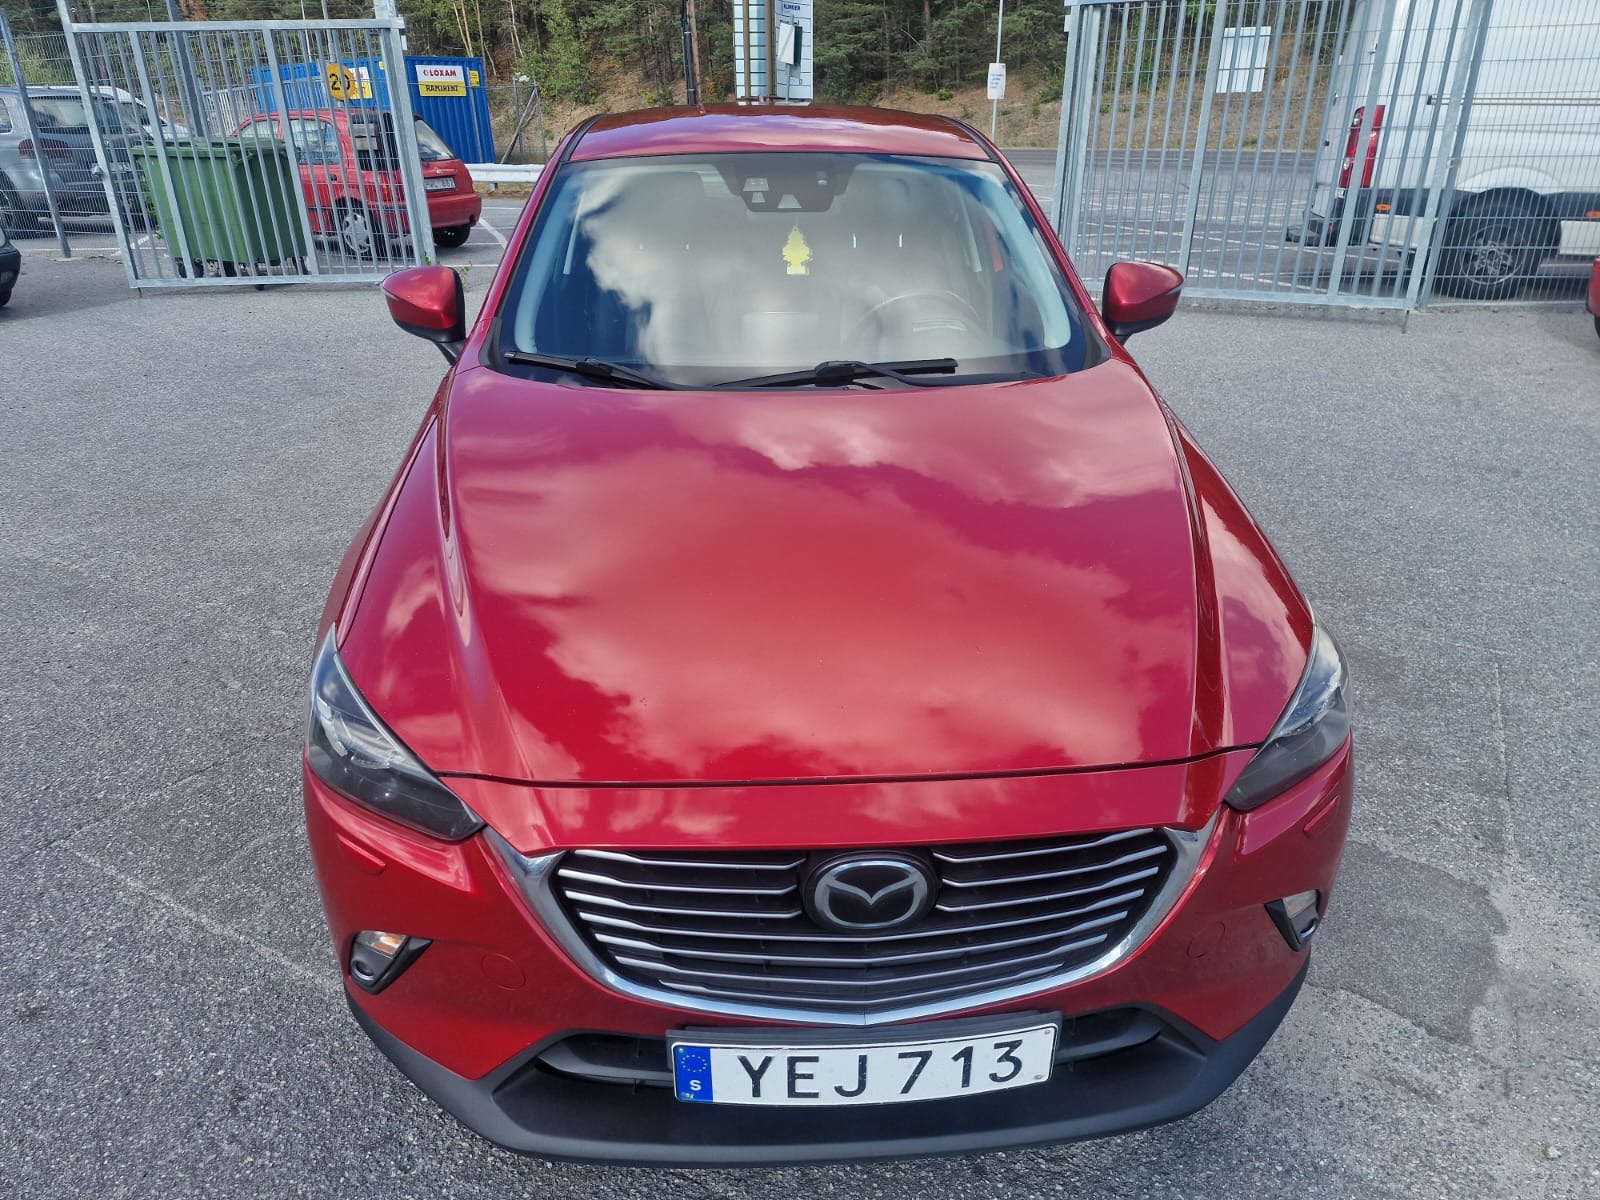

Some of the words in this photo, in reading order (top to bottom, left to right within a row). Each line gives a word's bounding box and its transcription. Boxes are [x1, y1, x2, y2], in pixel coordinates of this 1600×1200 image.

[429, 69, 457, 77] LOXAM
[329, 73, 351, 90] 20
[425, 84, 458, 92] RAMIRENT
[737, 1054, 868, 1099] YEJ
[898, 1039, 1023, 1095] 713
[689, 1079, 702, 1091] S
